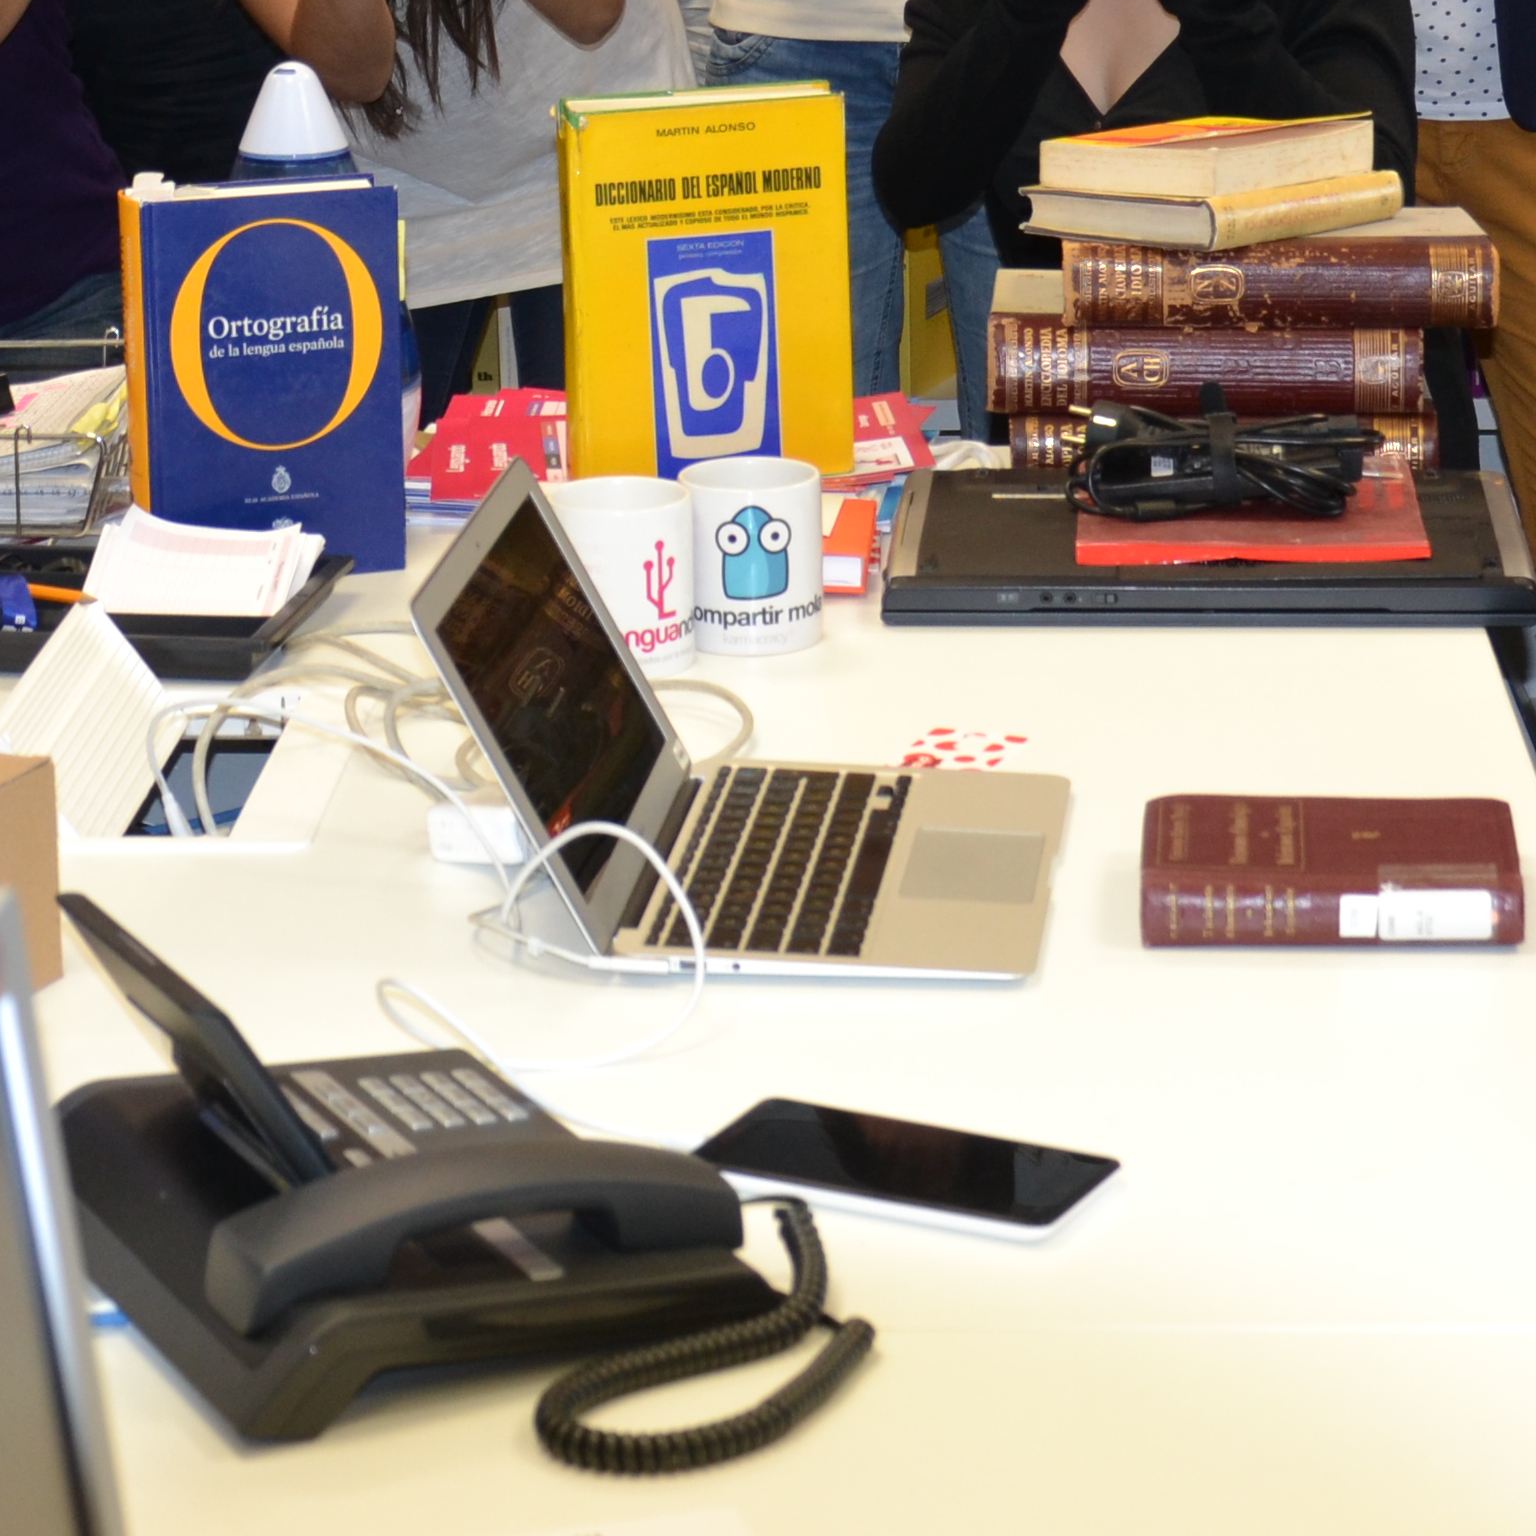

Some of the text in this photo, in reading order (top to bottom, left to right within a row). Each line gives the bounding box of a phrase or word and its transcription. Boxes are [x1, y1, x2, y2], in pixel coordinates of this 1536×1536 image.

[655, 122, 756, 138] MARTIN ALONSO
[594, 165, 822, 207] DICCIONARIO DEL ESPAÑOL MODERNO
[610, 216, 624, 225] ESTE
[650, 212, 696, 222] MODERNISIMO
[698, 209, 713, 218] ESTA
[760, 204, 773, 213] POR
[774, 203, 784, 211] LA
[612, 224, 620, 233] EL
[713, 216, 722, 224] DE
[723, 214, 740, 223] TODO
[741, 213, 749, 222] EL
[749, 211, 773, 222] MUNDO
[676, 240, 745, 253] SEXTA EDICION
[1467, 254, 1478, 311] AGUILAR
[207, 305, 345, 341] Ortografía
[208, 335, 345, 359] de la lengua española
[1023, 328, 1034, 407] MARTIN ALONSO
[1040, 327, 1053, 407] ENCICLOPEDIA
[1055, 327, 1068, 407] DEL IDIOMA
[1044, 423, 1055, 465] ALONSO
